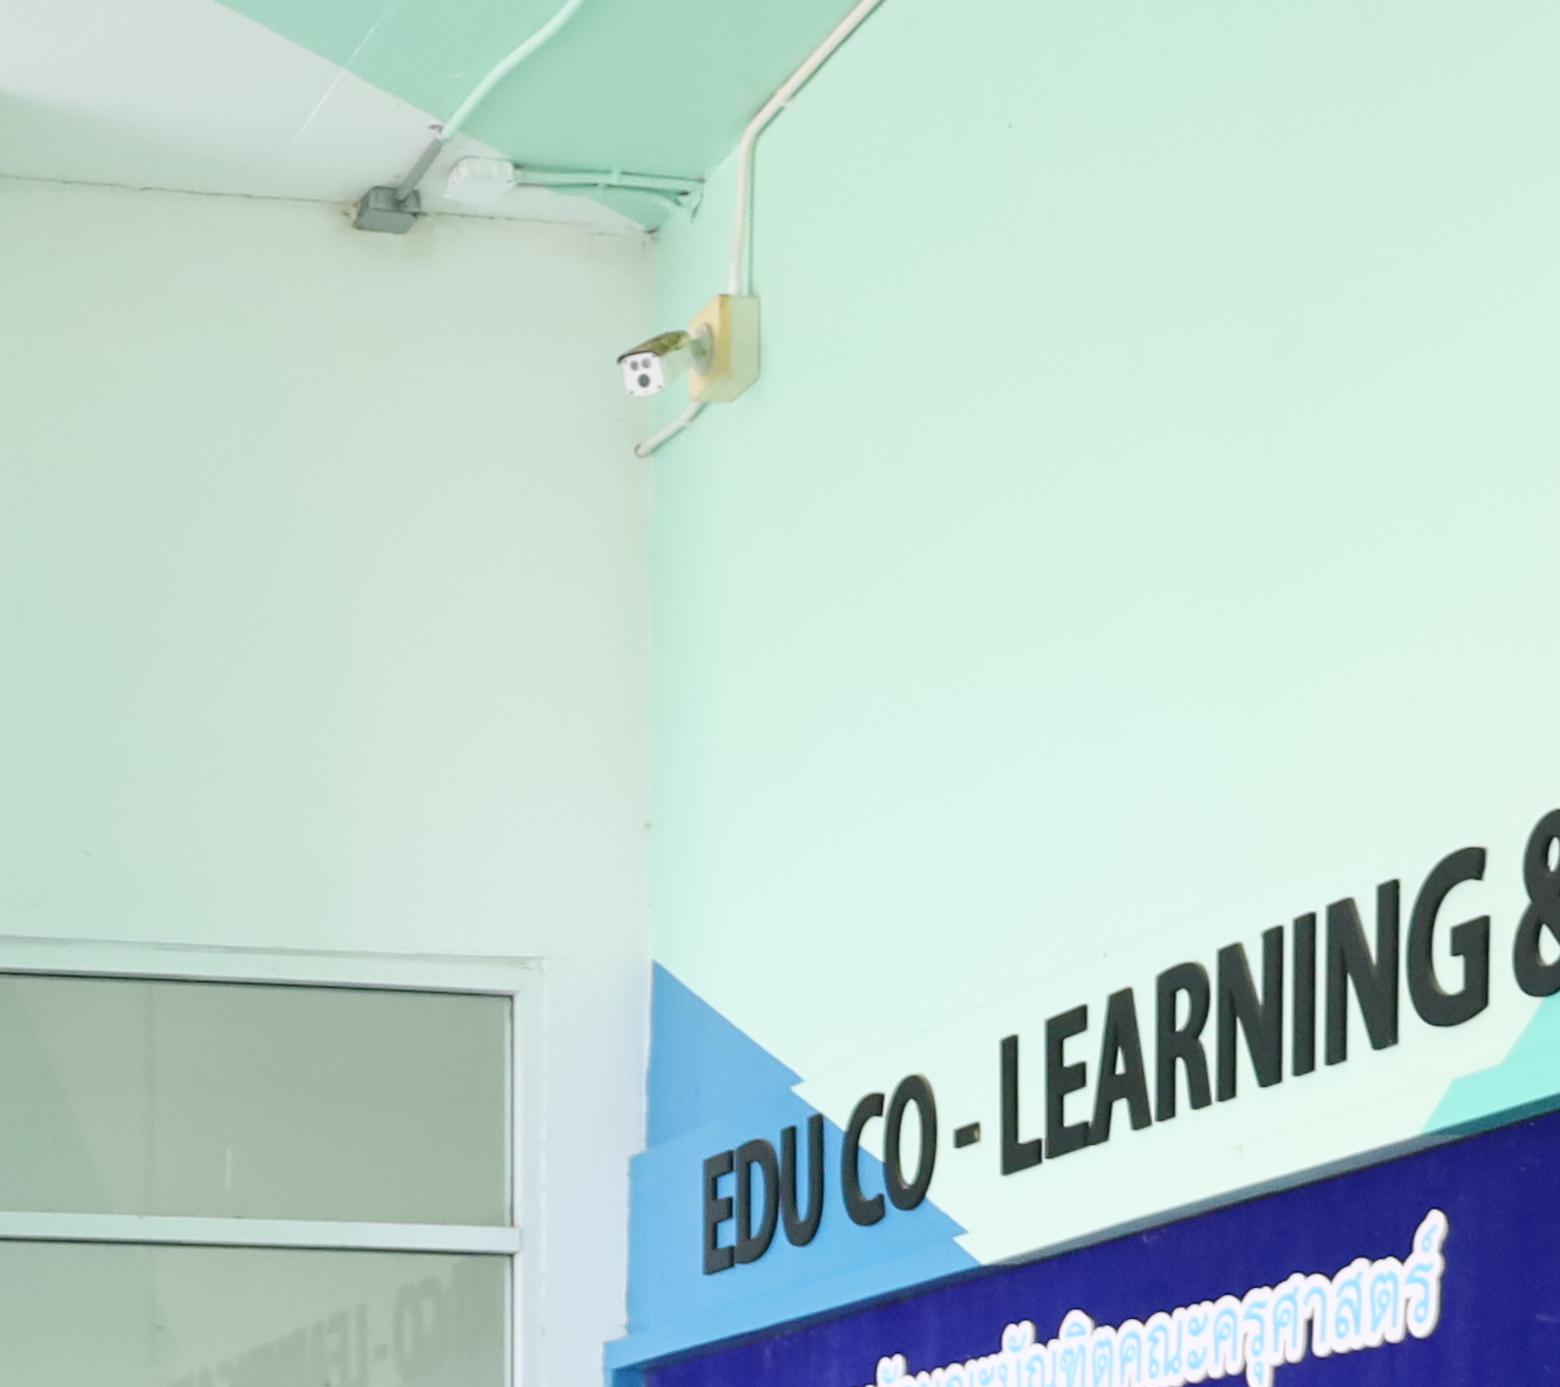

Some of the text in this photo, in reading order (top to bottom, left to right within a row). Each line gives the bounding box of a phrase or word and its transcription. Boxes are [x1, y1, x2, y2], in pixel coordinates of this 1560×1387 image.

[702, 1115, 825, 1276] EDU
[840, 1073, 938, 1228] CO
[999, 846, 1490, 1177] LEARNING
